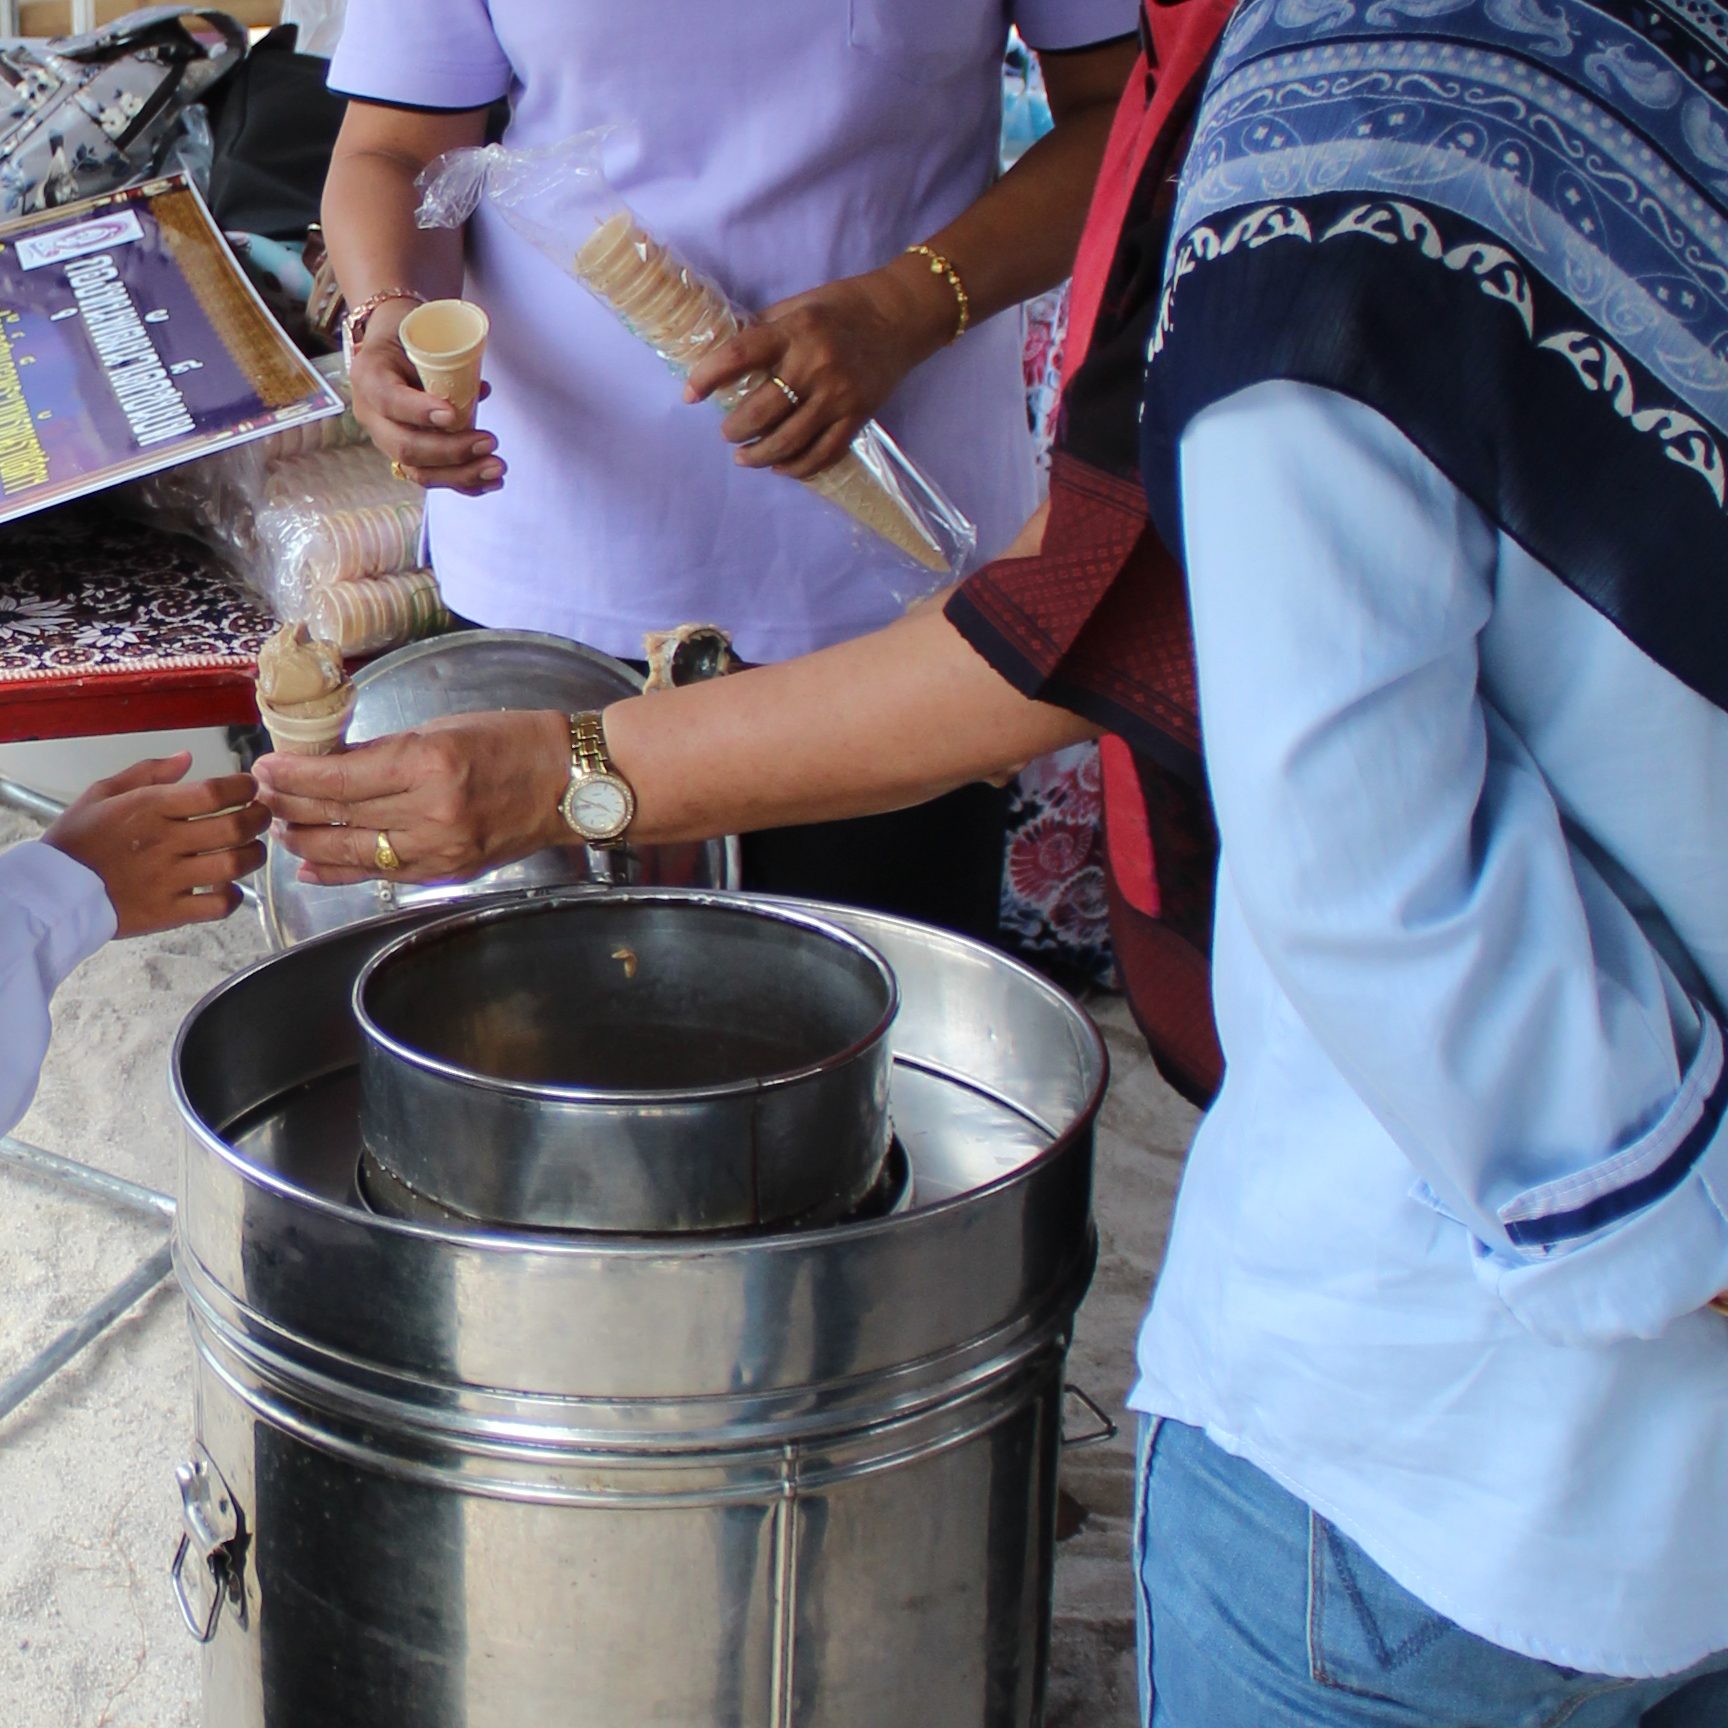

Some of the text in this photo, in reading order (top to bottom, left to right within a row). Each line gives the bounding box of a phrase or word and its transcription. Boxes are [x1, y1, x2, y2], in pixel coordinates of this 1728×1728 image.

[52, 254, 203, 447] กองทุนพัฒนาเด็กชนบท
